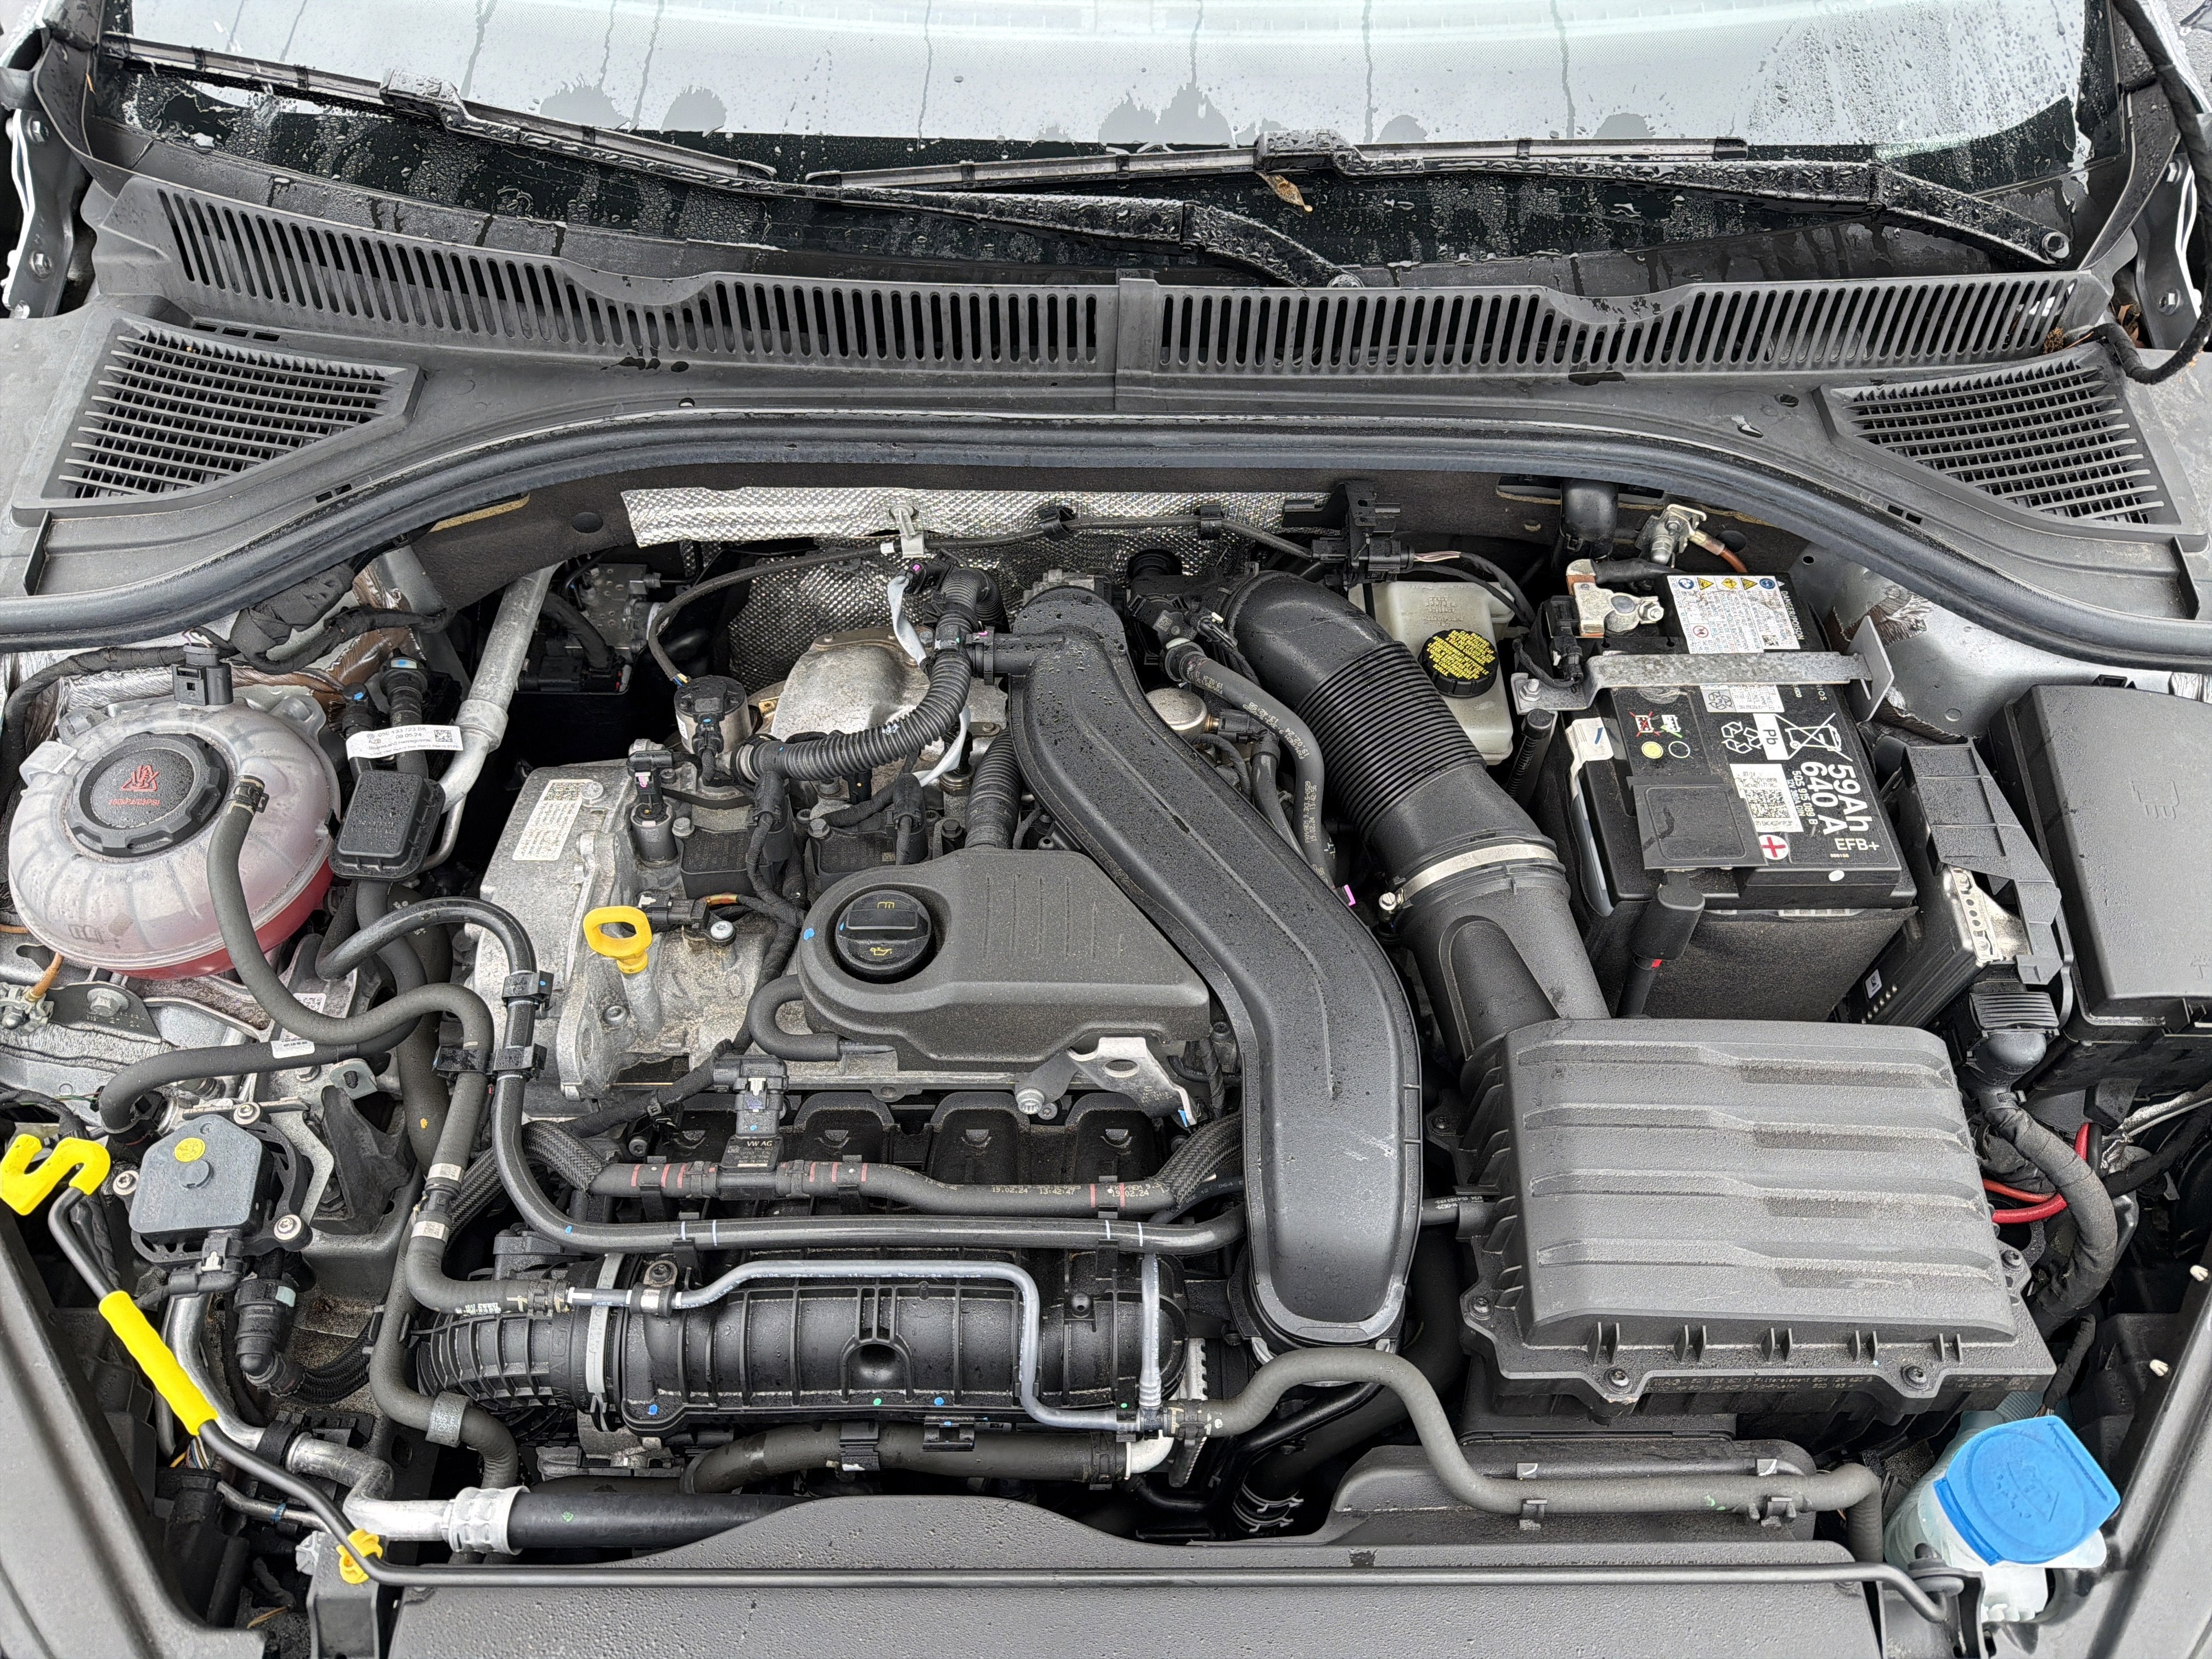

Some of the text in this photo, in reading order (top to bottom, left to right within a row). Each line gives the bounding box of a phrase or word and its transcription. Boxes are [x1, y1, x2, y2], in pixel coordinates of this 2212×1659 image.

[1781, 591, 1804, 640] DANGER/POISON
[1451, 630, 1468, 641] BEFORE
[1460, 630, 1474, 640] CLEAN
[1472, 639, 1486, 649] FILLER
[1471, 633, 1490, 646] WARNING:
[1433, 641, 1452, 654] BOUCHON
[1451, 653, 1465, 663] AVANT
[1448, 633, 1459, 641] ONLY
[1468, 647, 1481, 656] FLUID
[1479, 654, 1491, 663] FROM
[1448, 639, 1464, 650] SEALED
[1462, 648, 1486, 665] CONTAINER.
[1426, 647, 1442, 659] LIQUIDE
[1449, 663, 1472, 680] PROVENANT
[1438, 661, 1462, 678] CONTENANT
[1463, 656, 1483, 671] NETTOYER
[1284, 727, 1310, 758] 19.02.24
[1762, 729, 1779, 746] Pb
[1786, 778, 1797, 789] 12V
[1795, 805, 1805, 816] DIN
[1798, 788, 1810, 802] 915
[1800, 761, 1848, 835] 640 A
[1827, 764, 1873, 832] 59Ah
[1803, 801, 1816, 817] 089
[1309, 816, 1317, 842] 19.02.24
[1833, 838, 1880, 851] EFB+
[1039, 1187, 1075, 1195] 13:42:47
